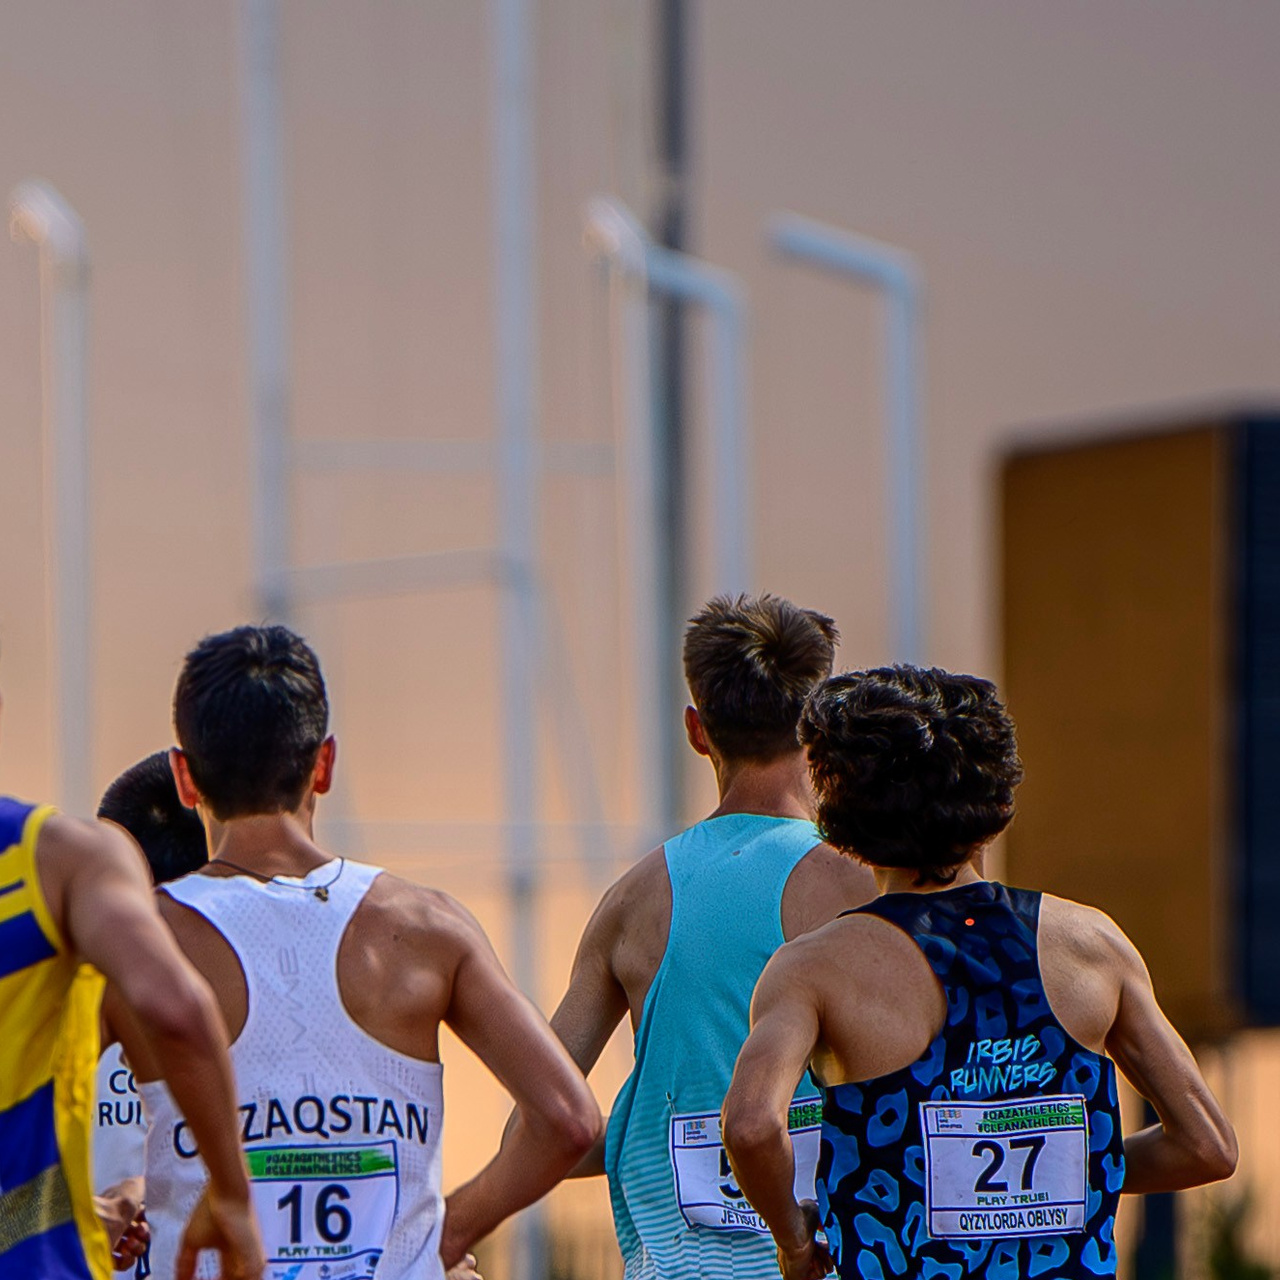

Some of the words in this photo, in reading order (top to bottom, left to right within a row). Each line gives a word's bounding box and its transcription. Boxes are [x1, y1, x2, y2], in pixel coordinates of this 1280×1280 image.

[966, 1033, 1041, 1064] IRBIS
[950, 1061, 1058, 1094] RUNNERS
[977, 1116, 1078, 1133] #CLEANATHLETICS
[982, 1103, 1070, 1121] #QAZATHLETICS
[971, 1135, 1047, 1193] 27
[277, 1183, 353, 1244] 16
[976, 1196, 1009, 1206] PLAY
[959, 1211, 1027, 1231] QYZYLORDA
[1027, 1208, 1069, 1227] OBLYSY
